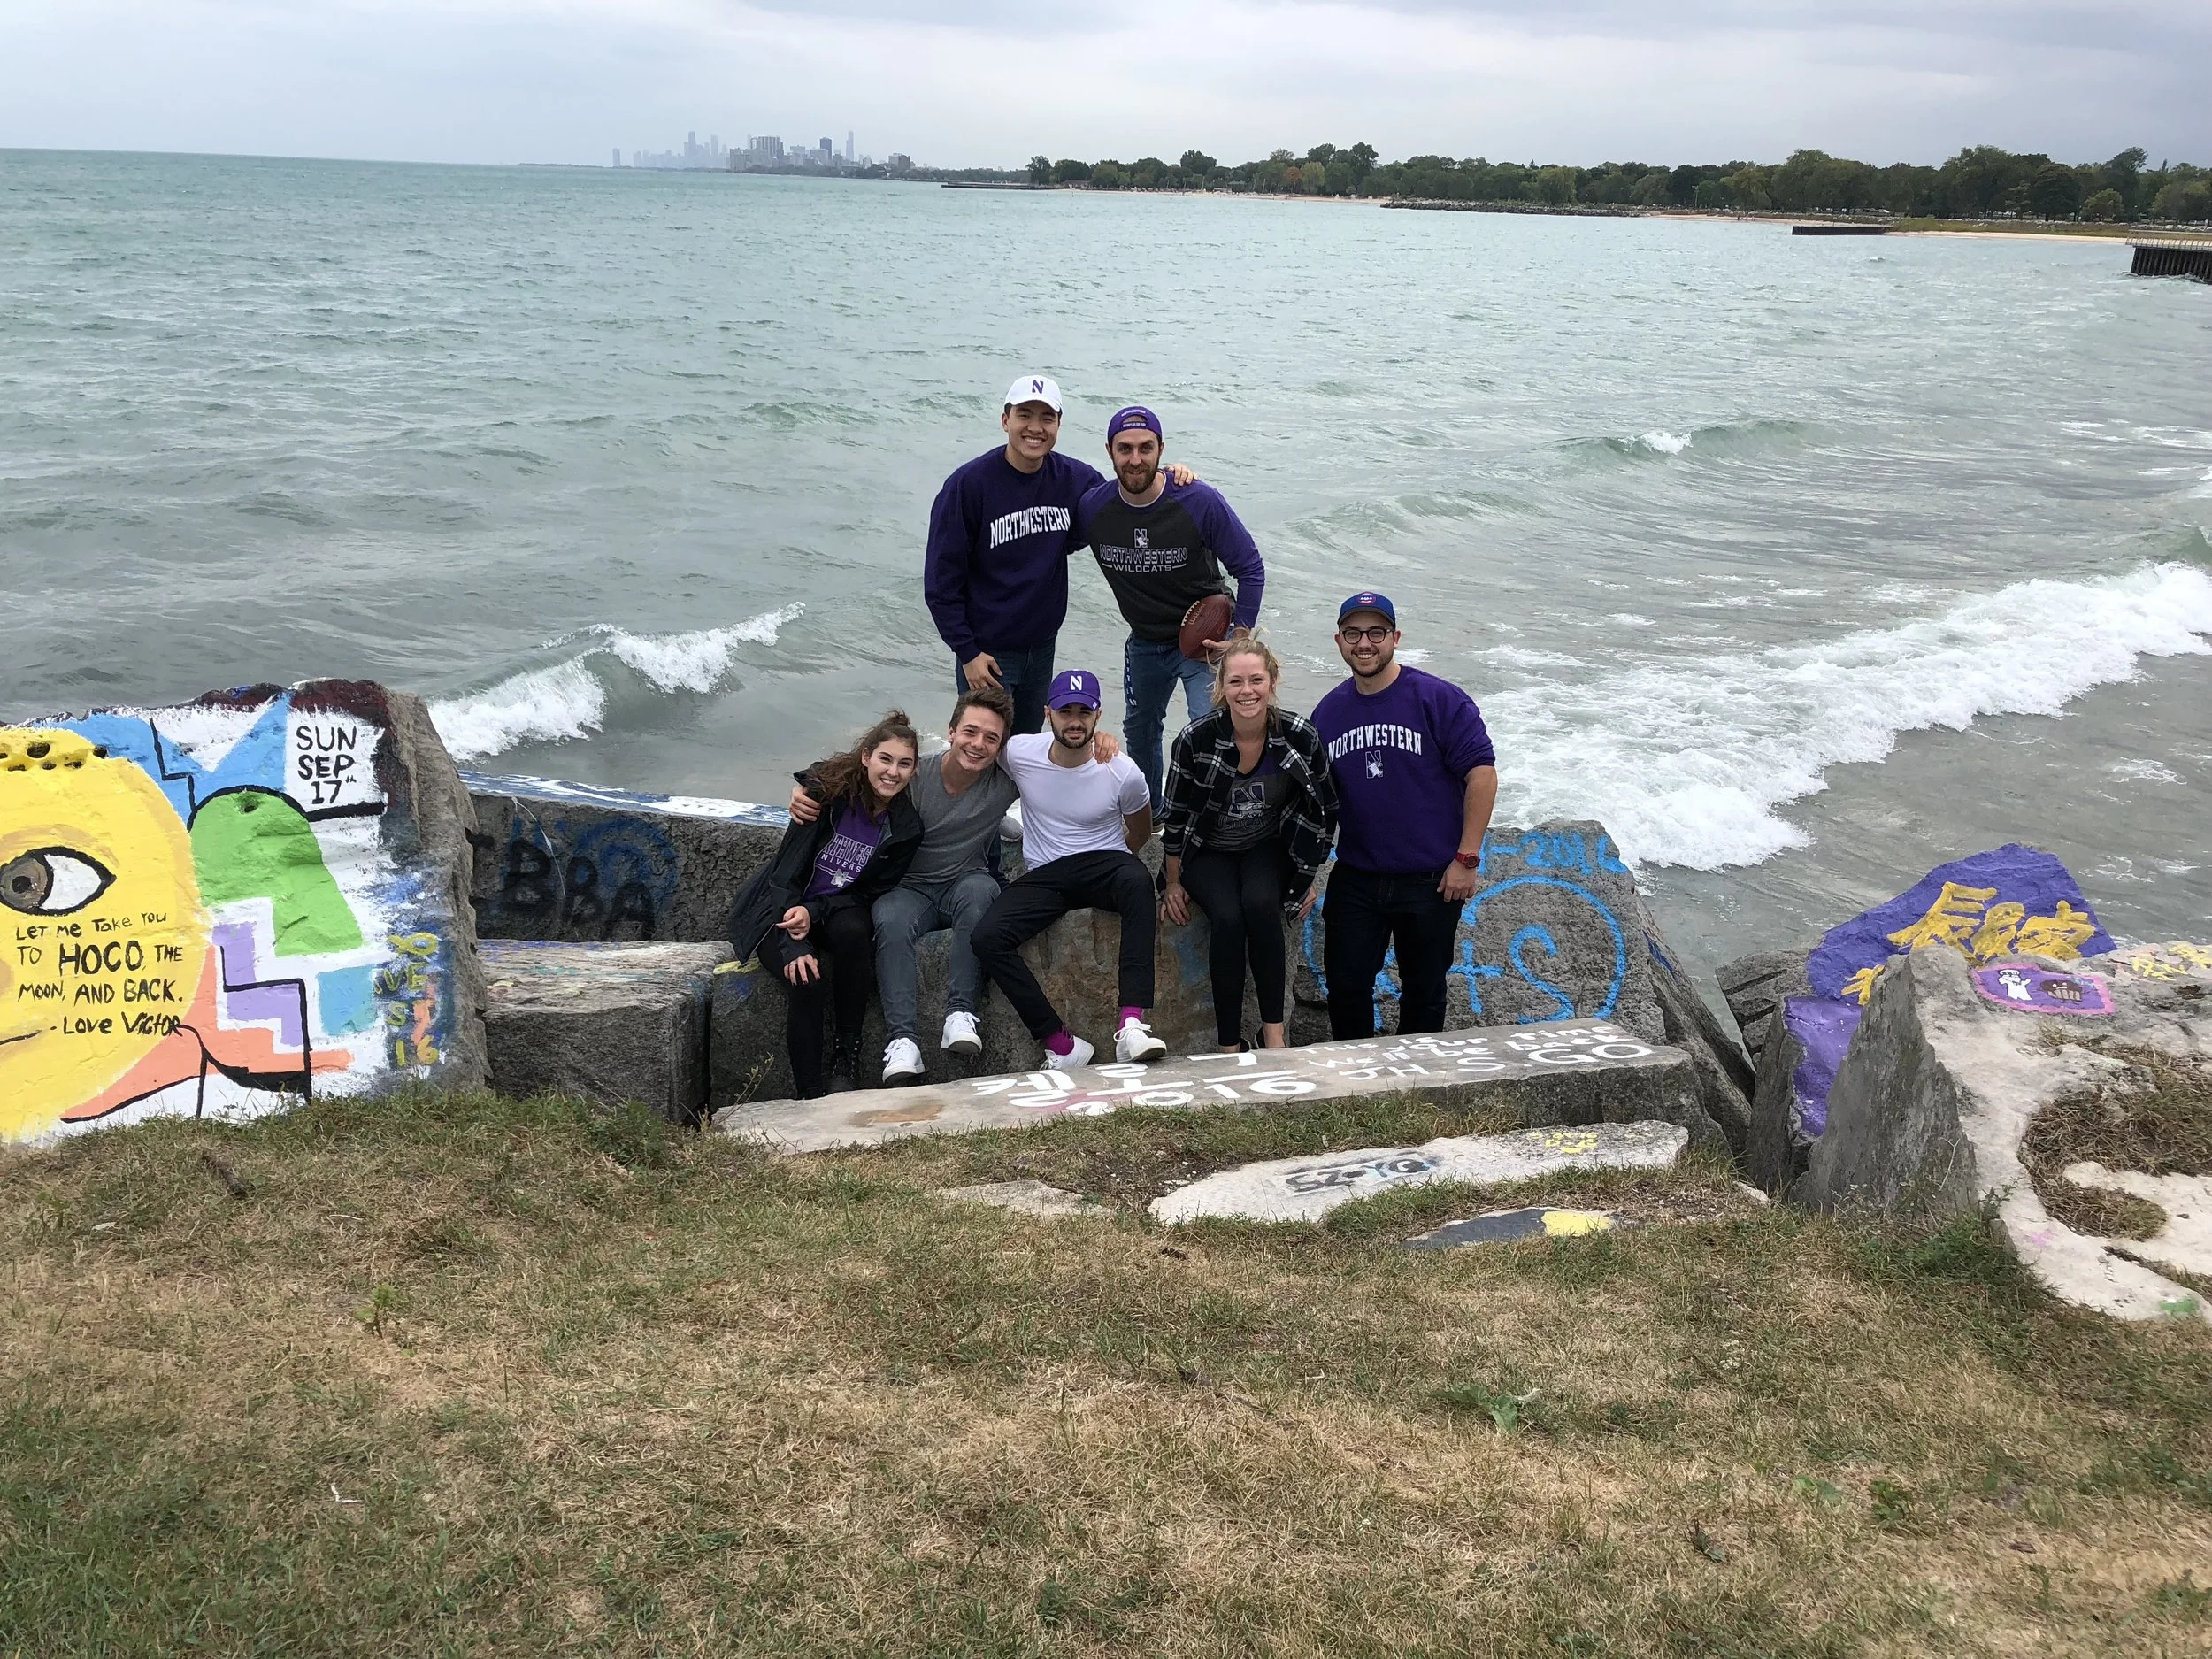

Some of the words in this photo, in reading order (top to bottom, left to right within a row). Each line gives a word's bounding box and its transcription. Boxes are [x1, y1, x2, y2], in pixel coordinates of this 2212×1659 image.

[1032, 380, 1044, 395] N
[989, 506, 1071, 549] NORTHWESTERN
[1099, 544, 1187, 565] NORTHWESTERN
[1113, 563, 1172, 573] WILDCATS
[1070, 675, 1082, 691] N
[296, 726, 357, 752] SUN
[1327, 724, 1422, 763] NORTHWESTERN
[297, 754, 356, 780] SEP
[92, 917, 133, 932] Take
[17, 945, 42, 965] TO
[154, 944, 183, 963] THE
[73, 983, 115, 1007] AND
[1504, 1033, 1635, 1051] back
[1509, 1026, 1615, 1041] time
